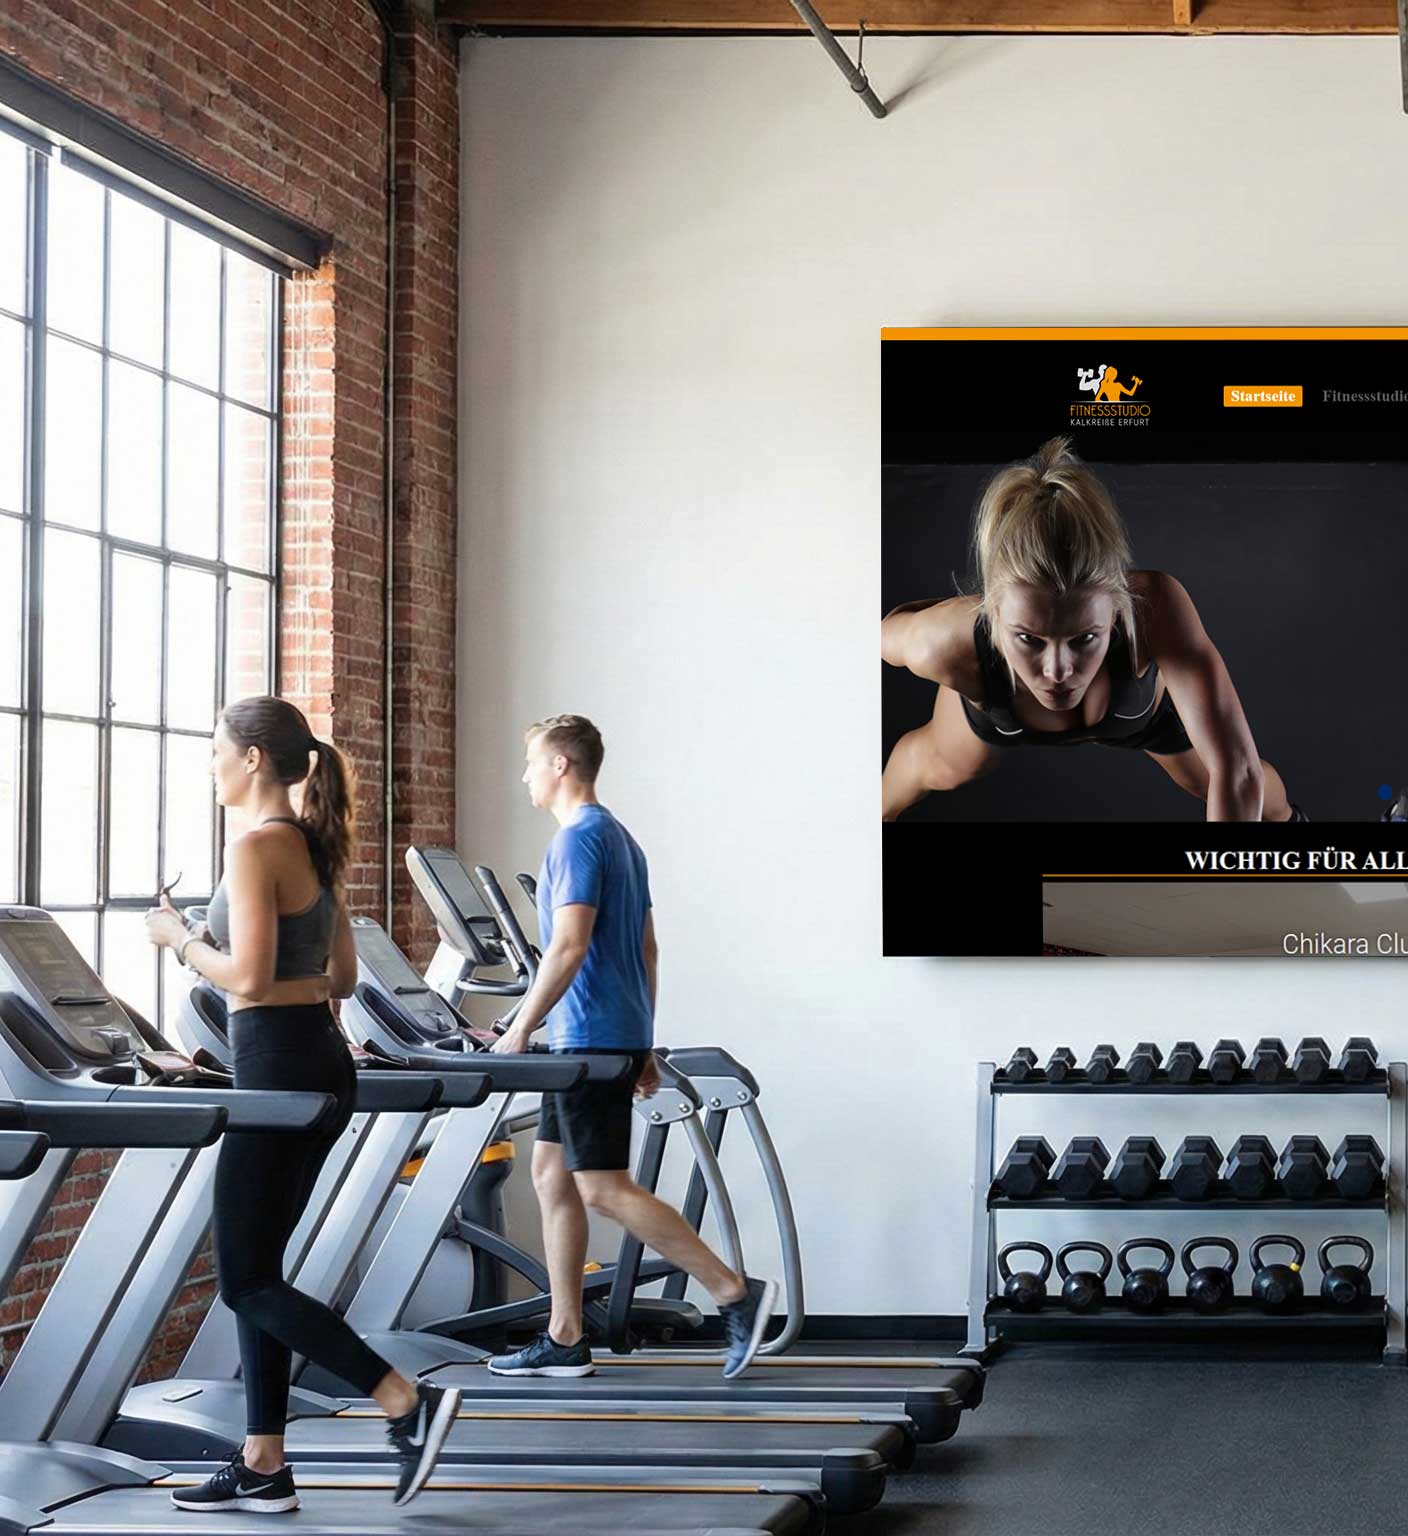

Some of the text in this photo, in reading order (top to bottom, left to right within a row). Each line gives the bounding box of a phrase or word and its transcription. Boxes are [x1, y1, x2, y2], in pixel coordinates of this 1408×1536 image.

[1231, 390, 1296, 402] Startseite
[1070, 404, 1151, 417] FITNESSSTUDIO
[1184, 851, 1301, 870] WICHTIG
[1307, 846, 1358, 870] FÜR
[1283, 932, 1369, 954] Chikara
